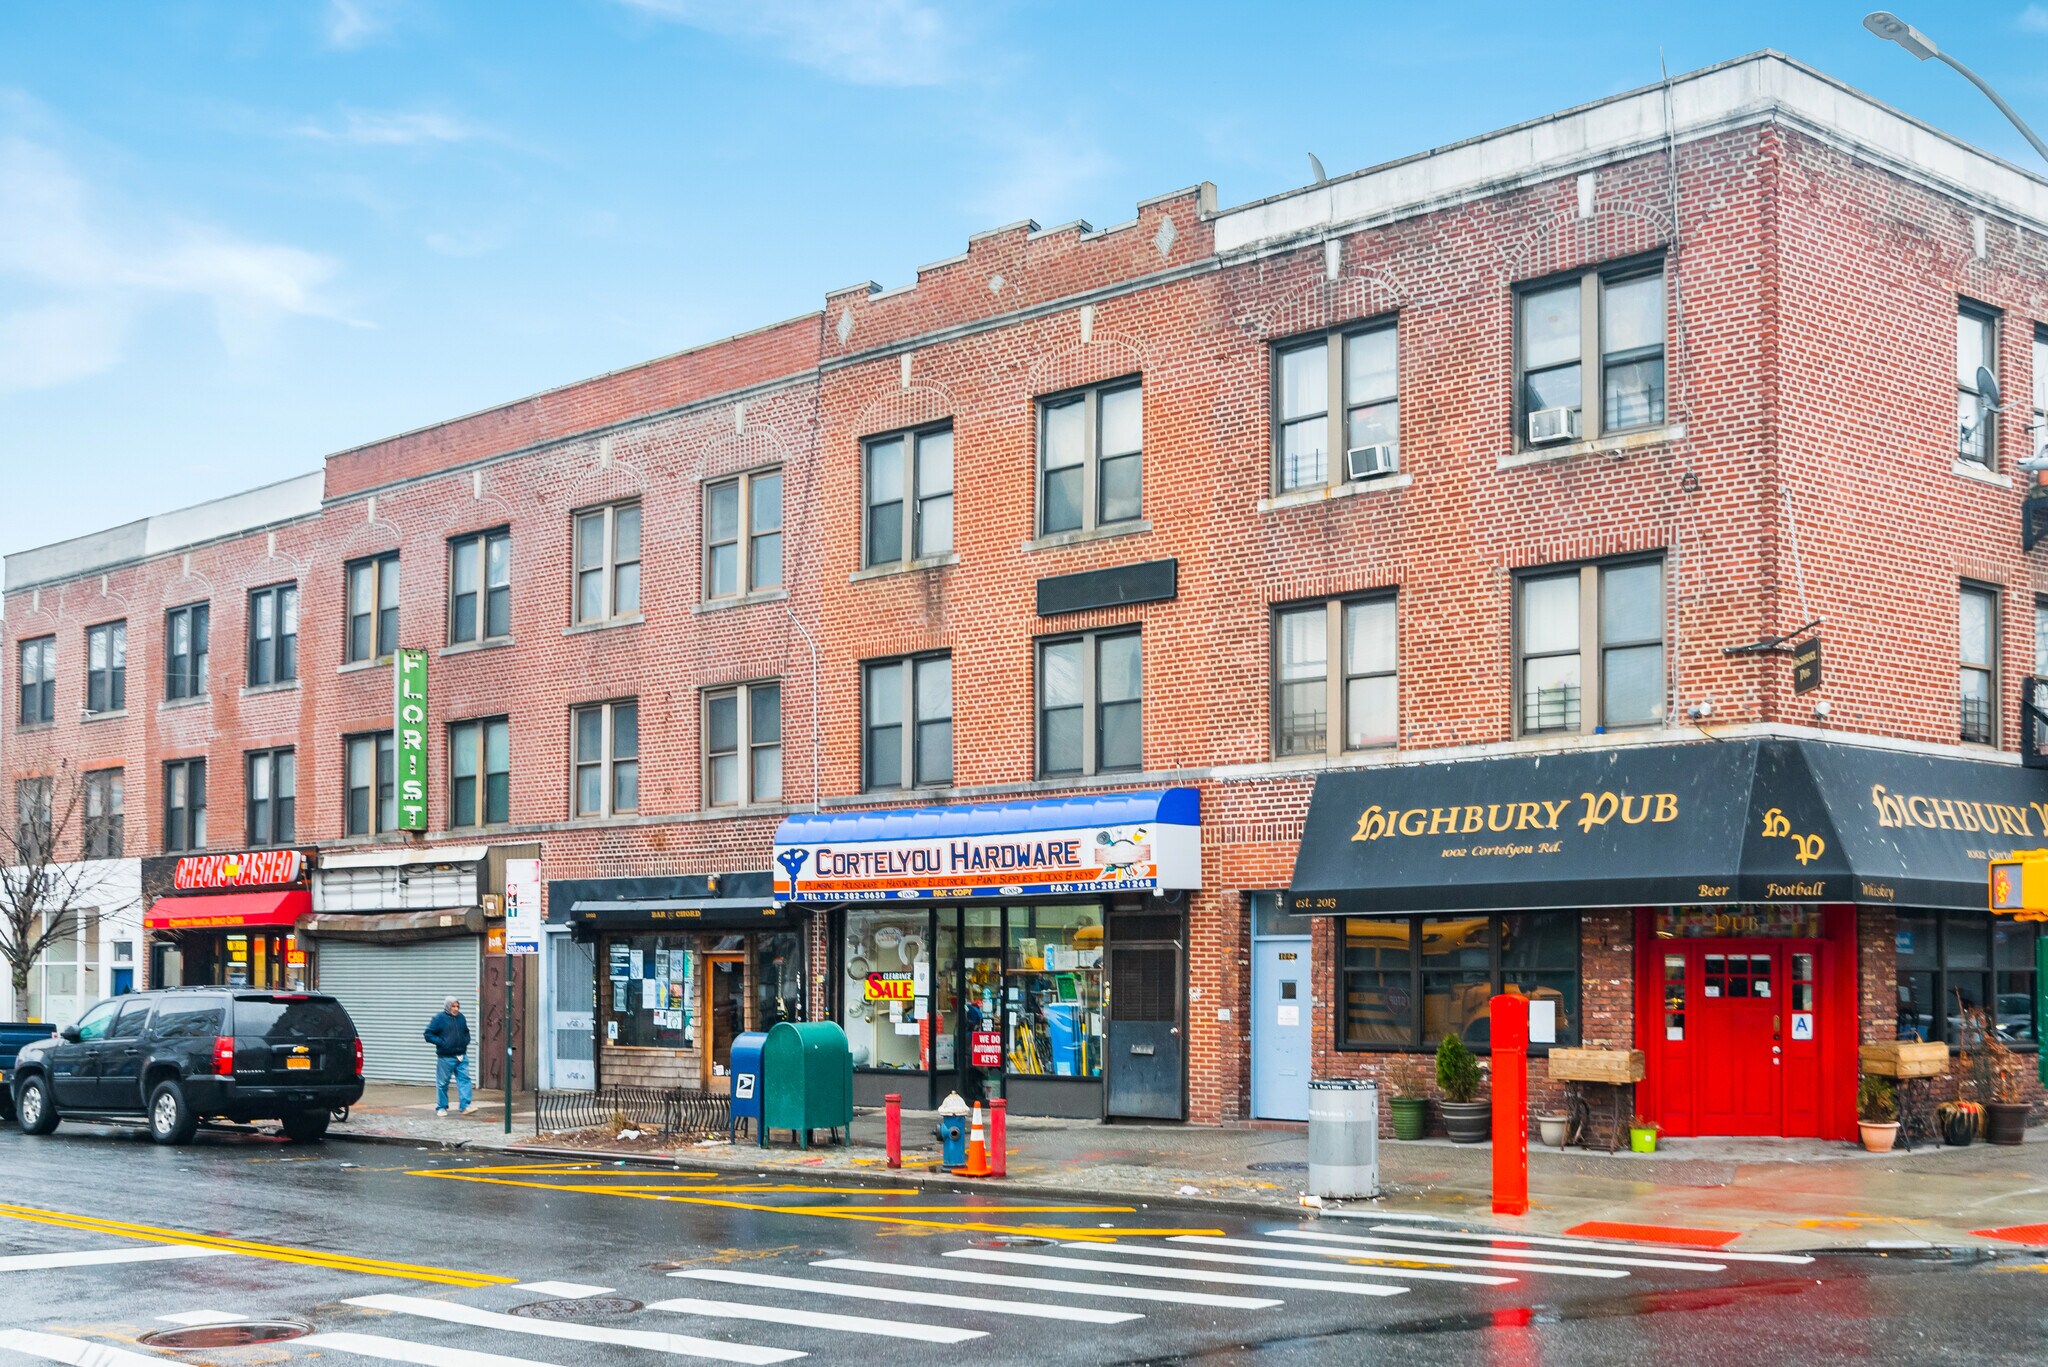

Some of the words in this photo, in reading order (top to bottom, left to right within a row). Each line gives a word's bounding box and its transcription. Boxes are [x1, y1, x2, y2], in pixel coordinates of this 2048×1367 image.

[402, 653, 424, 826] FLORIST
[1350, 799, 1571, 842] HIGHBURY
[1577, 790, 1679, 834] PUB
[1872, 784, 2034, 837] HIGHBURY
[1441, 848, 1466, 858] 1002
[1471, 844, 1533, 859] Cortelyou
[1538, 841, 1561, 854] Rd.
[815, 848, 941, 876] CORTELYOU
[950, 840, 1081, 873] HARDWARE
[175, 854, 230, 889] CHECKS
[232, 850, 294, 886] CASHED
[885, 878, 920, 887] HARDWARE
[928, 876, 967, 886] ELECTRICAL
[976, 875, 996, 885] PAINT
[1000, 873, 1033, 883] SUPPLIES
[1074, 872, 1094, 880] KEYS
[1050, 884, 1073, 892] FAX:
[1077, 880, 1152, 891] 718-282-1268
[803, 892, 821, 900] TEL:
[823, 891, 886, 900] 718-282-0650
[932, 889, 948, 897] FAX
[952, 888, 973, 897] COPY
[1697, 883, 1730, 897] Beer
[1764, 881, 1826, 899] Football
[1861, 880, 1895, 902] Whiskey
[1295, 897, 1312, 908] est.
[1316, 897, 1337, 909] 2013
[651, 911, 666, 919] BAR
[675, 909, 702, 918] CHORD
[1713, 913, 1760, 932] PUB
[882, 972, 912, 980] CLEARANCE
[868, 972, 912, 999] SALE
[609, 1024, 616, 1034] A
[1795, 1017, 1808, 1032] A
[979, 1035, 990, 1043] WE
[991, 1035, 1001, 1043] DO
[981, 1055, 998, 1063] KEYS
